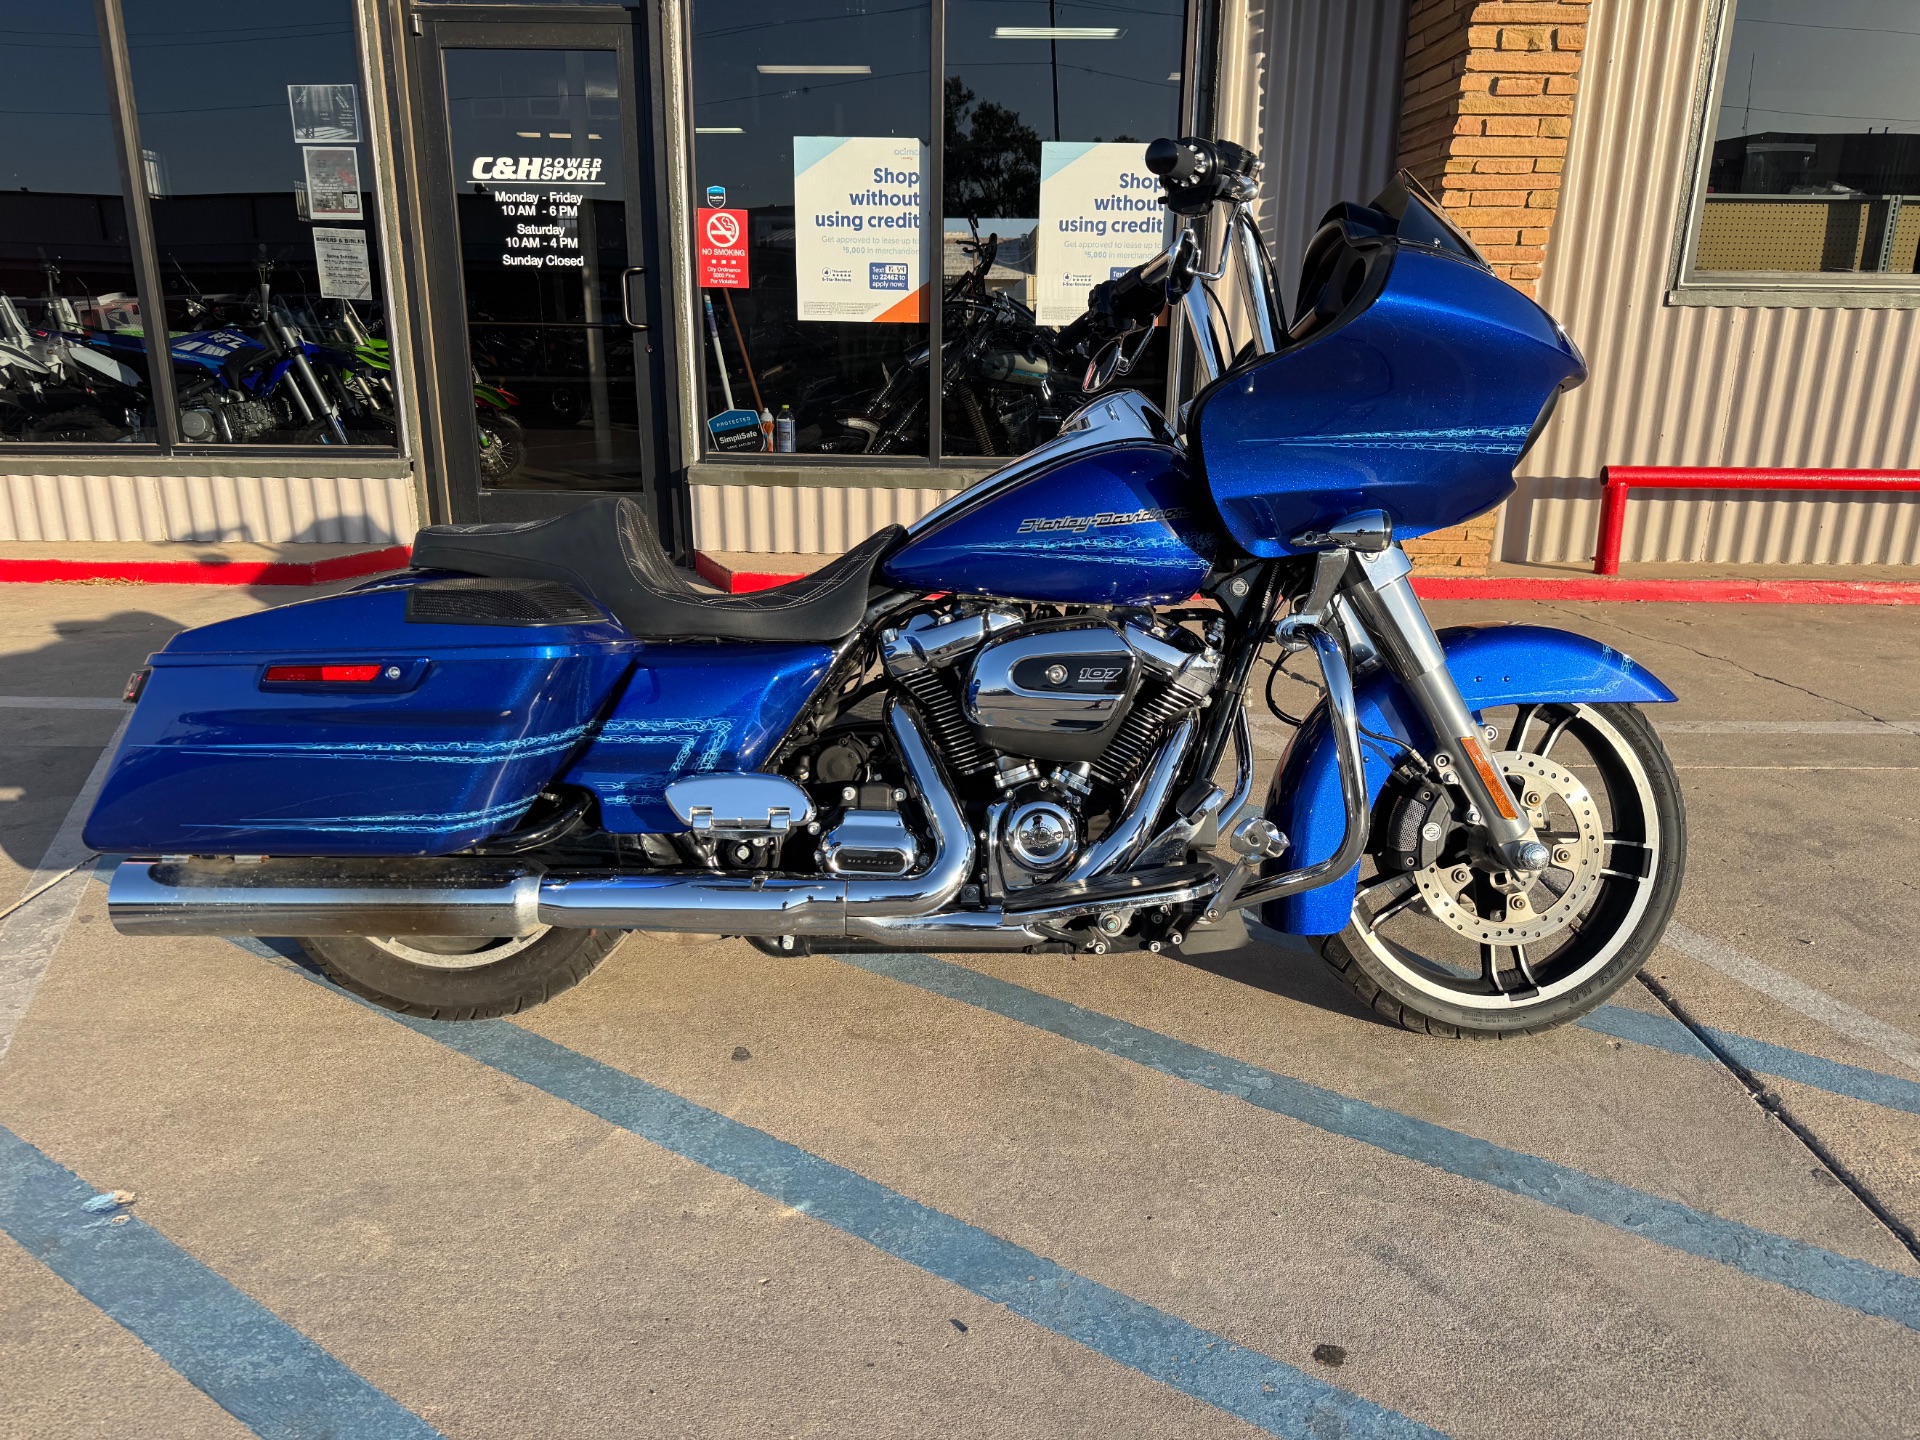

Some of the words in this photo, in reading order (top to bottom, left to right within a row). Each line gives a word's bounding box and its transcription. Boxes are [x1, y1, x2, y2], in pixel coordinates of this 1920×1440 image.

[472, 156, 543, 180] C&H
[543, 157, 603, 168] POWER
[541, 167, 601, 181] SPORT
[873, 167, 919, 188] Shop
[1119, 172, 1164, 193] Shop
[495, 191, 539, 205] Monday
[549, 192, 583, 206] Friday
[849, 189, 919, 207] without
[501, 205, 516, 216] 10
[517, 205, 536, 216] AM
[549, 206, 557, 217] 6
[559, 206, 578, 217] PM
[815, 210, 863, 231] using
[867, 212, 919, 228] credit
[1058, 215, 1107, 236] using
[1111, 216, 1163, 233] credit
[517, 224, 565, 237] Saturday
[505, 237, 520, 248] 10
[521, 237, 540, 248] AM
[550, 238, 557, 248] 4
[559, 238, 579, 249] PM
[821, 235, 835, 243] Get
[836, 236, 871, 245] approved
[872, 236, 880, 244] to
[881, 236, 900, 244] lease
[901, 237, 911, 246] up
[1063, 240, 1077, 248] Get
[1078, 241, 1113, 250] approved
[1114, 241, 1122, 249] to
[1123, 241, 1142, 249] lease
[1143, 242, 1153, 251] up
[702, 248, 712, 256] NO
[713, 248, 746, 257] SMOKING
[842, 246, 866, 255] $5,000
[866, 246, 874, 254] in
[1084, 251, 1107, 259] $5,000
[1108, 251, 1115, 259] in
[502, 254, 544, 268] Sunday
[546, 255, 584, 267] Closed
[872, 266, 885, 274] Text
[872, 280, 889, 289] apply
[716, 416, 751, 427] PROTECTED
[719, 430, 758, 444] SimpliSafe
[1016, 506, 1191, 534] Harley-Davidson
[1079, 667, 1123, 680] 107
